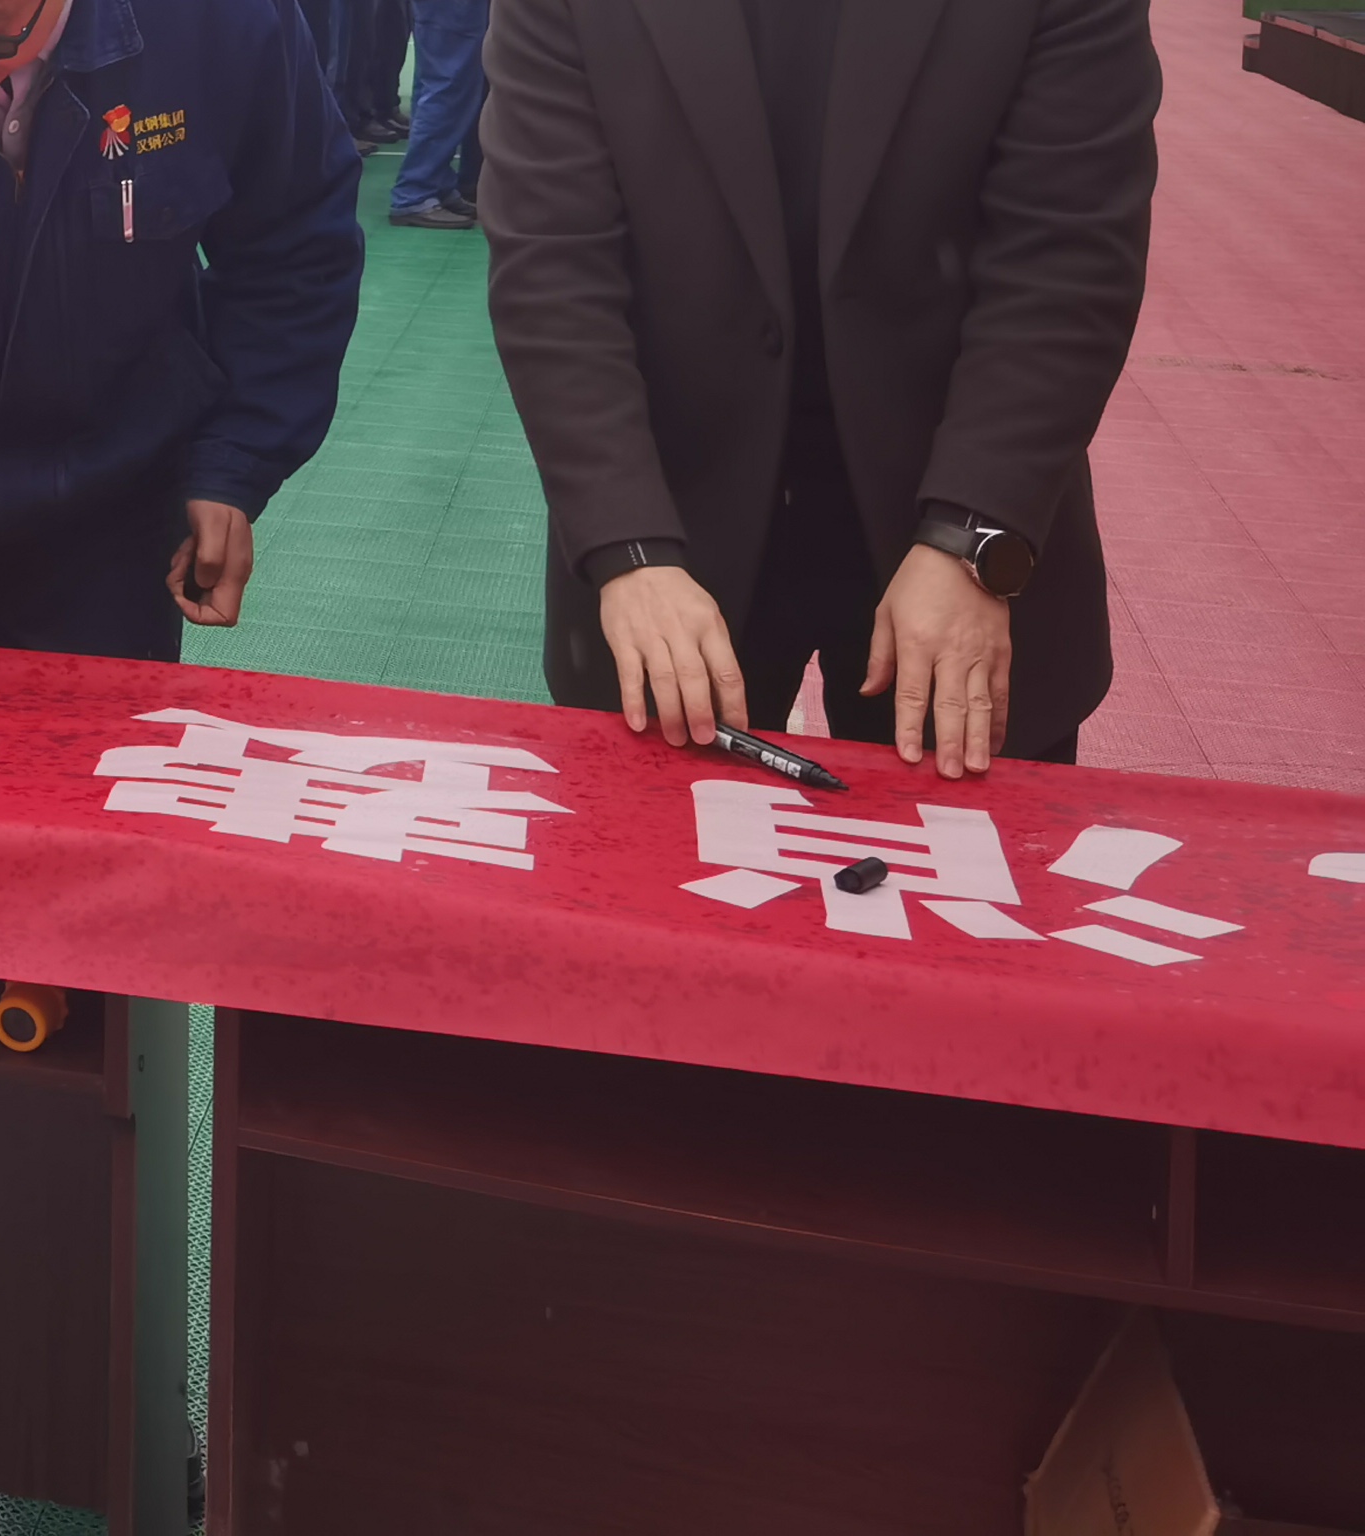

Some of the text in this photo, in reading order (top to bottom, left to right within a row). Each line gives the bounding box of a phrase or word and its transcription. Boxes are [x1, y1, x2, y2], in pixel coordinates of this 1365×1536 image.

[135, 127, 186, 155] 汉钢公司
[93, 707, 1365, 967] 消费
